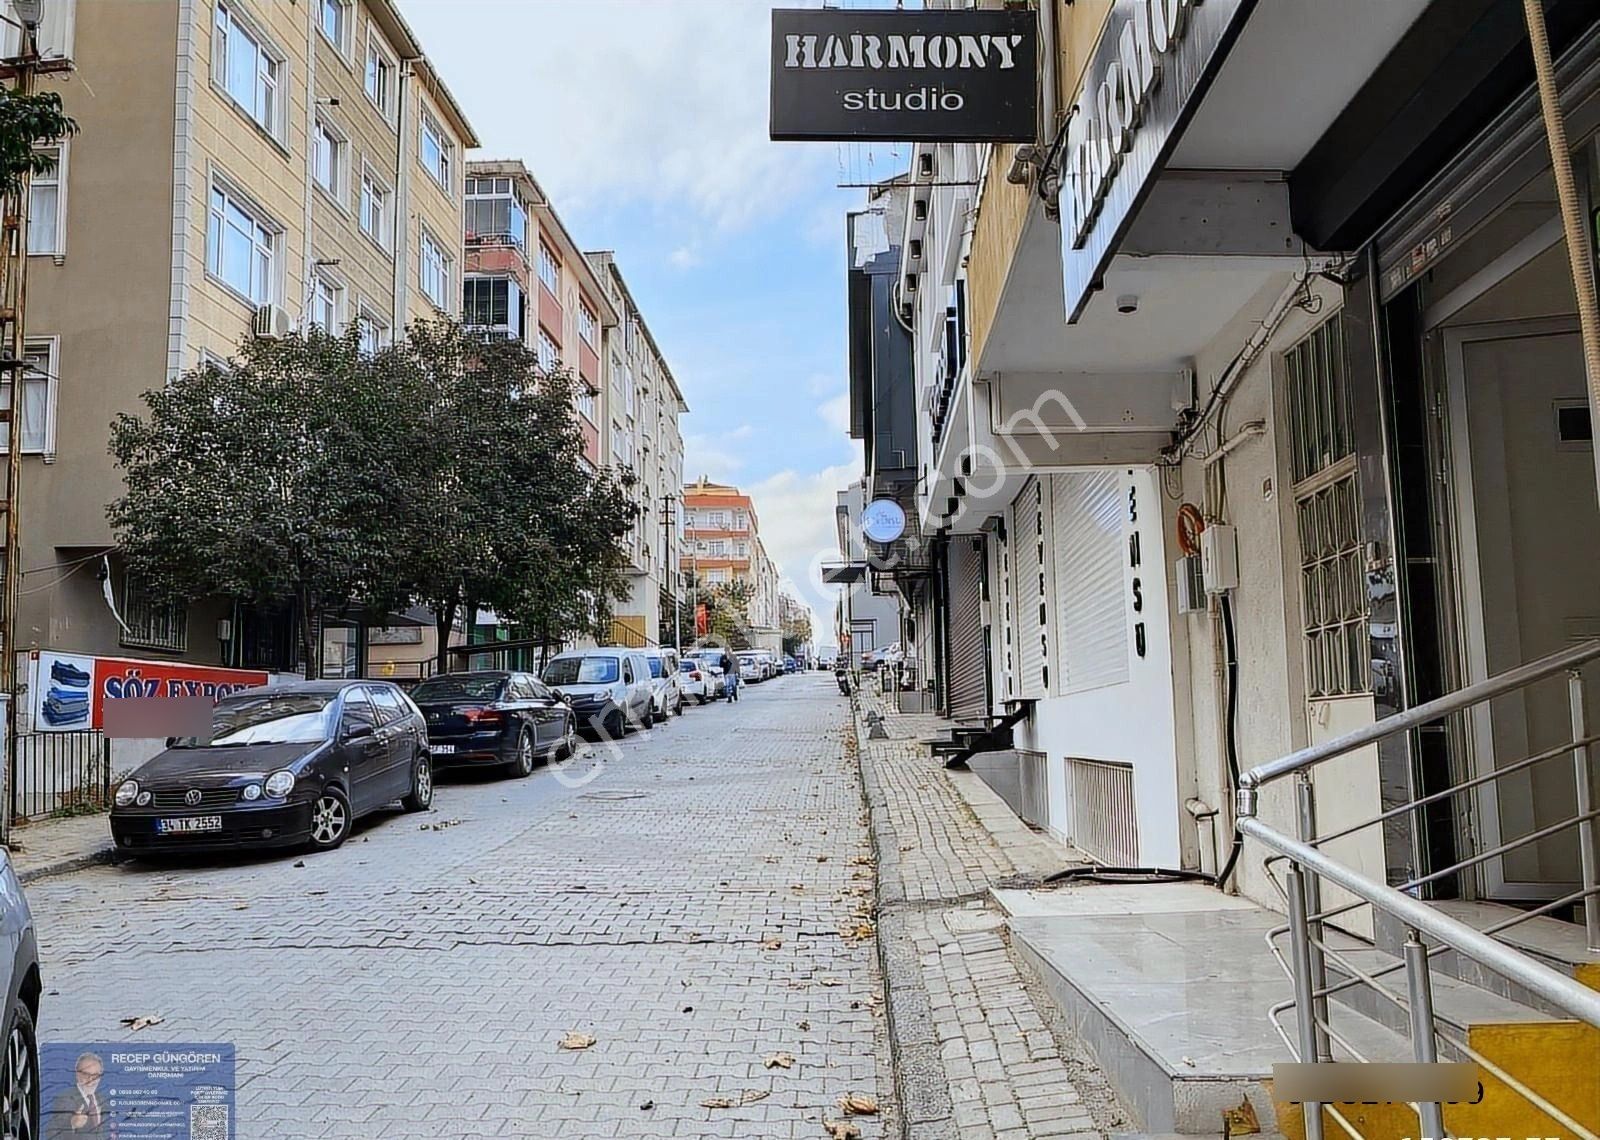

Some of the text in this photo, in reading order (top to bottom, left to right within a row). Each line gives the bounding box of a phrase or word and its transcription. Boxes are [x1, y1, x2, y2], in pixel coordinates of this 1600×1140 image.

[784, 34, 1023, 69] HARMONY
[842, 87, 965, 112] studio
[162, 819, 175, 831] 34
